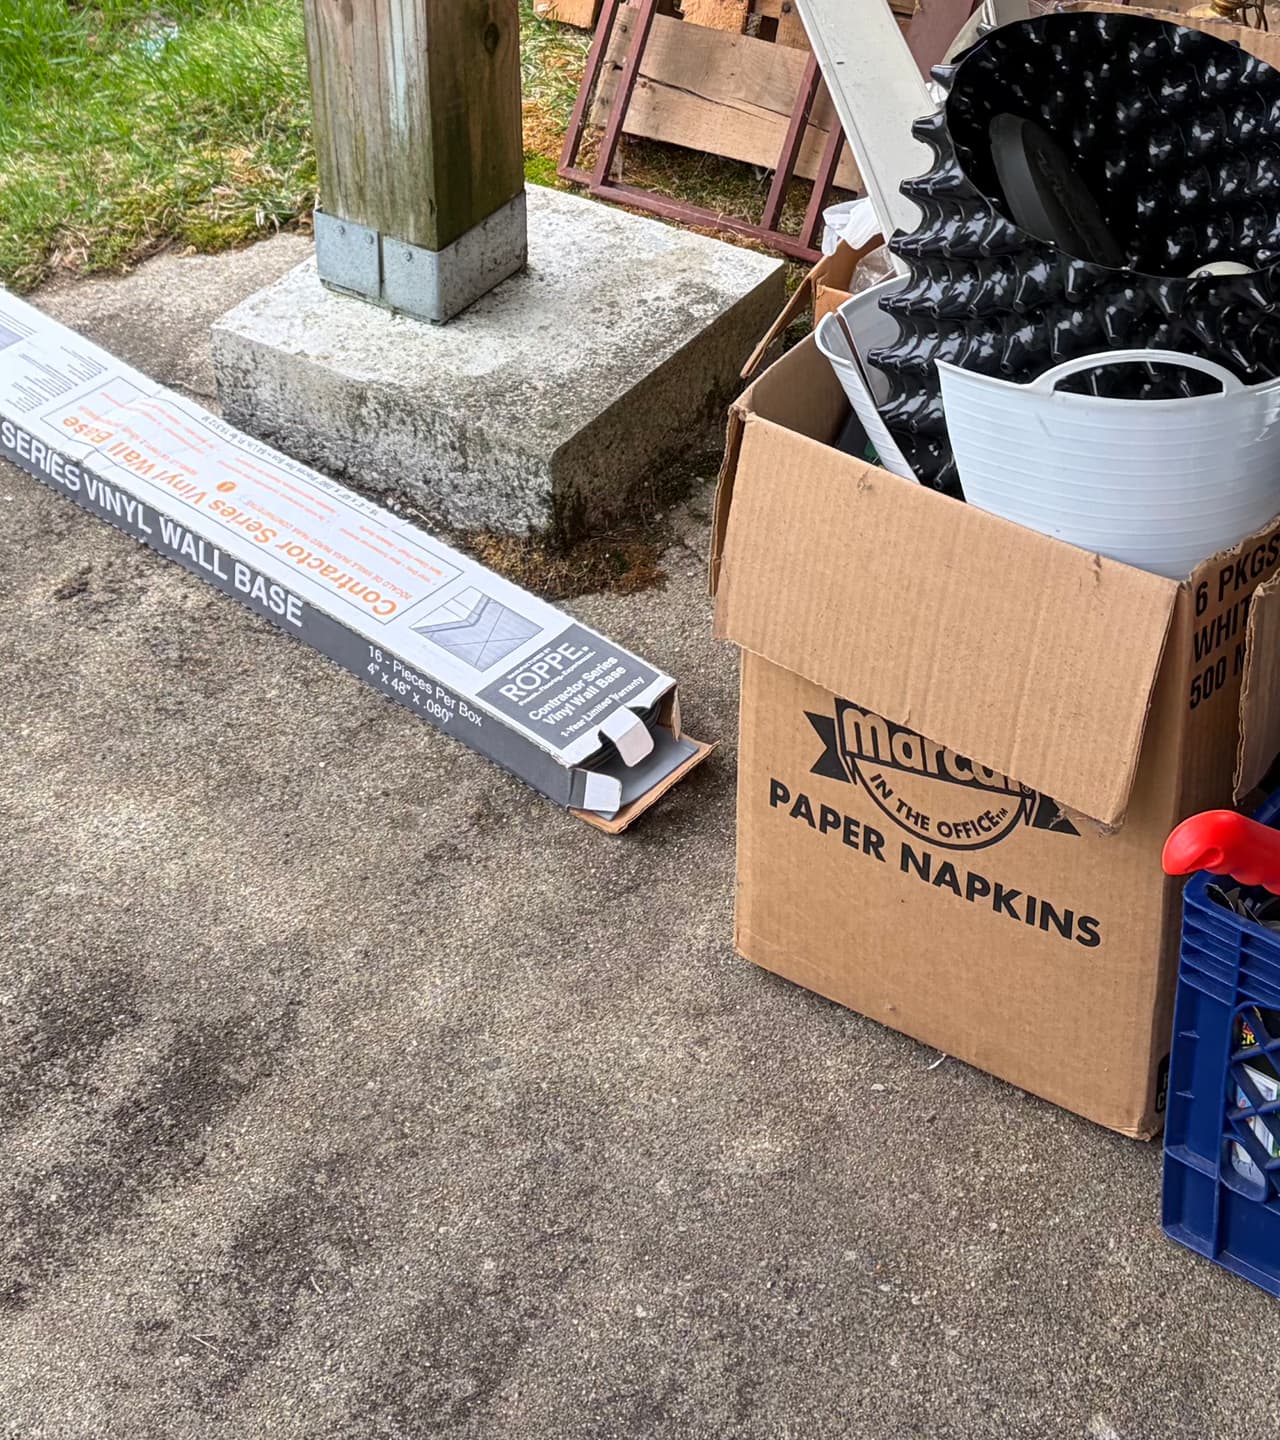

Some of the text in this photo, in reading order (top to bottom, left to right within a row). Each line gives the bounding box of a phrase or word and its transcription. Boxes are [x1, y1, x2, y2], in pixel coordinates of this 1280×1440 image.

[63, 416, 113, 443] Base
[107, 442, 156, 475] Wall
[152, 469, 208, 506] Vinyl
[1, 422, 81, 491] SERIES
[84, 473, 152, 534] VINYL
[159, 516, 228, 580] WALL
[235, 562, 303, 627] BASE
[208, 499, 277, 543] Series
[275, 541, 397, 616] Contractor
[1195, 581, 1209, 617] 6
[1194, 592, 1252, 663] WHIT
[369, 646, 383, 662] 16
[393, 660, 433, 695] Pieces
[436, 687, 456, 709] Per
[459, 703, 483, 727] Box
[381, 672, 389, 685] x
[412, 692, 420, 705] x
[528, 657, 618, 720] Contractor Series
[542, 666, 626, 725] Vinyl Wall Base
[560, 675, 645, 738] 1-Year Limited Warranty
[1190, 656, 1227, 709] 500
[870, 773, 894, 800] IN
[896, 798, 931, 832] THE
[770, 778, 1102, 948] PAPER NAPKINS
